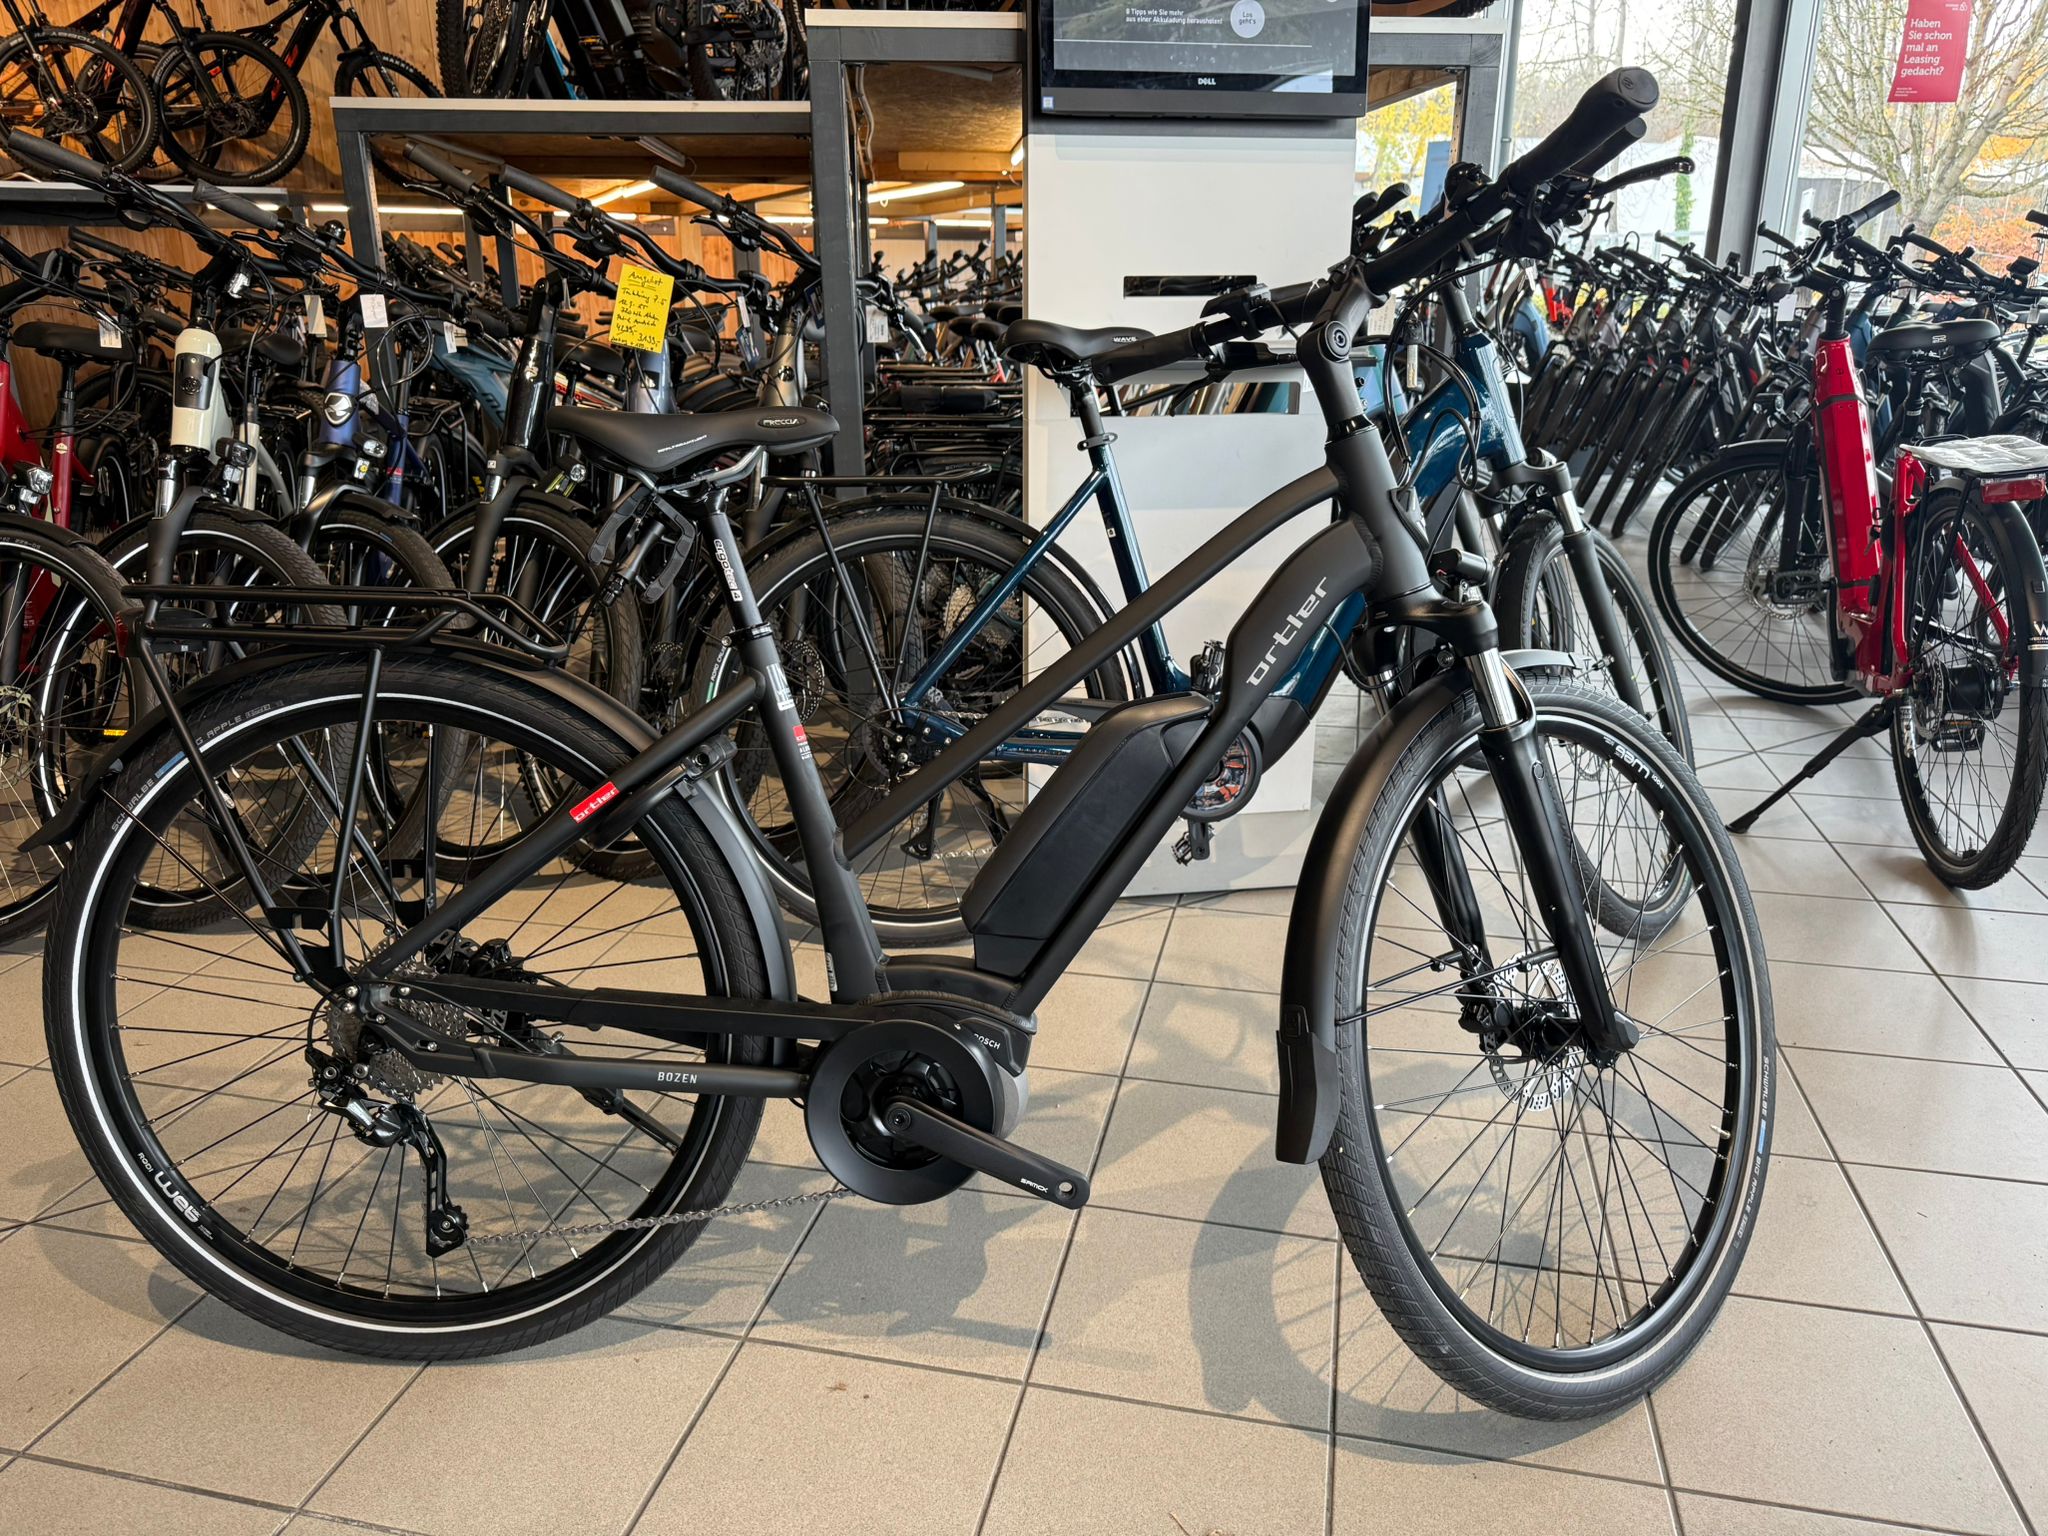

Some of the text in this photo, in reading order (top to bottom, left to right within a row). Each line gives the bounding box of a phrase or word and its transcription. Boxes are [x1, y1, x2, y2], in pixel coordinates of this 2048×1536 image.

[1131, 8, 1147, 16] Tipps
[1152, 16, 1186, 24] Akkuladung
[1910, 18, 1941, 28] Haben
[1908, 30, 1953, 40] Sie schon
[1906, 43, 1938, 52] mal an
[1904, 54, 1940, 65] Leasing
[1901, 66, 1944, 77] gedacht?
[1198, 78, 1216, 86] DELL
[628, 271, 663, 287] Angebot
[714, 538, 738, 589] ergotec
[1245, 576, 1327, 686] ortler
[206, 716, 242, 739] APPLE
[657, 1071, 698, 1084] BOZEN
[1761, 1056, 1769, 1117] SCHWALBE
[137, 1152, 154, 1173] RODI
[1746, 1178, 1758, 1213] APPLE
